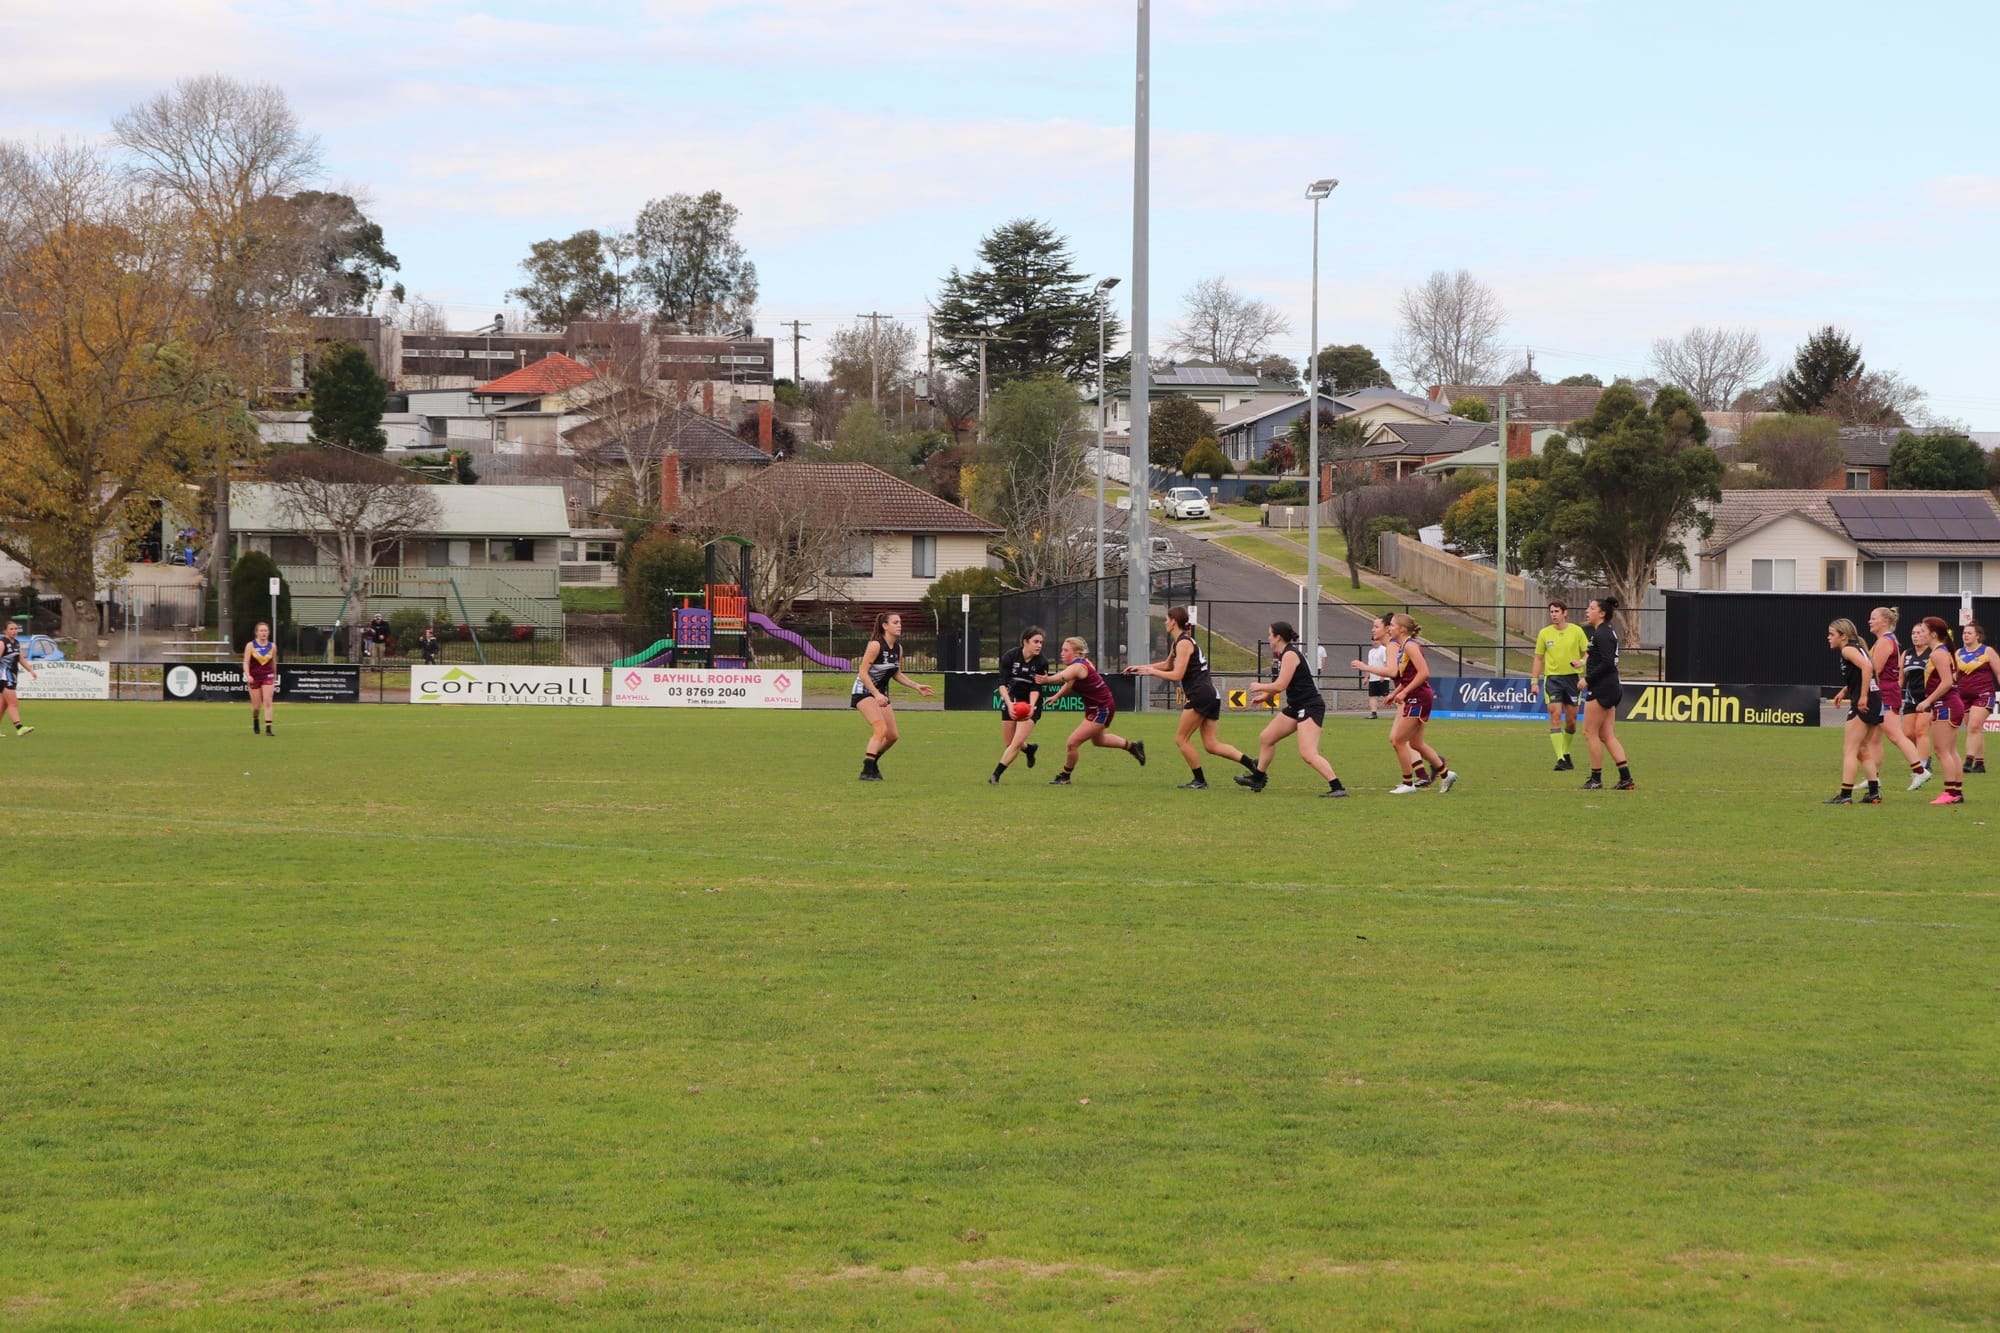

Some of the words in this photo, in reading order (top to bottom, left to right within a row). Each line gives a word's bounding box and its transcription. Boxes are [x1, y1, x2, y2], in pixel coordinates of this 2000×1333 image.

[46, 662, 105, 677] CONTRACTING
[202, 671, 240, 683] Hoskin
[652, 673, 704, 684] BAYHILL
[420, 678, 592, 695] cornwall
[668, 687, 683, 697] 03
[686, 687, 715, 697] 8769
[717, 688, 747, 698] 2040
[1459, 681, 1537, 704] Wakefield
[486, 695, 586, 704] BUILDING
[764, 696, 799, 704] BAYHILL
[1626, 686, 1740, 723] Allchin
[1744, 708, 1805, 725] Builders
